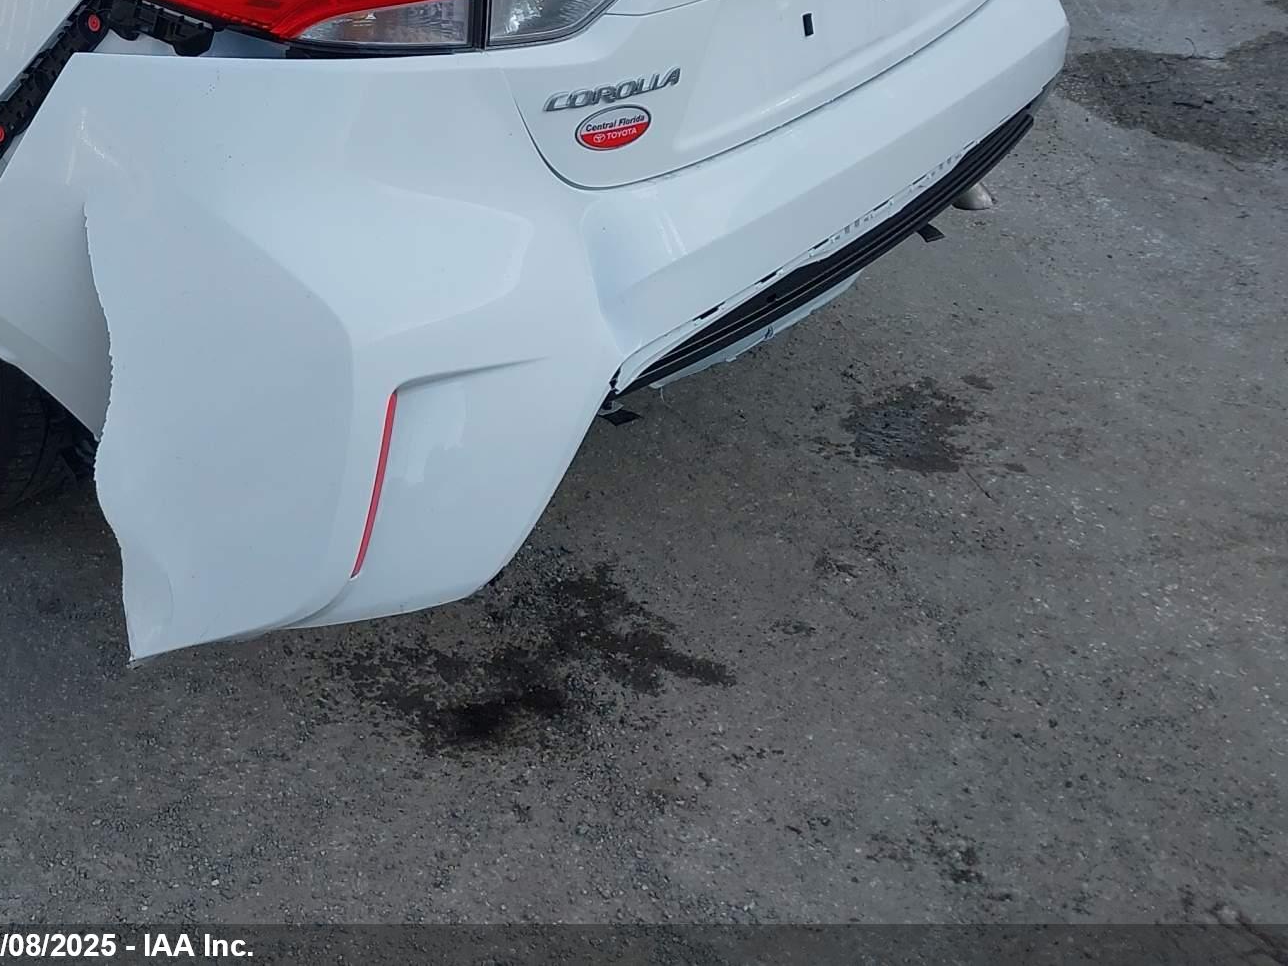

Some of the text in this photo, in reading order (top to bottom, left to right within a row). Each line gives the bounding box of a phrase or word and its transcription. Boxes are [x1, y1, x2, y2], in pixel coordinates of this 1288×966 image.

[543, 66, 681, 112] COROLLA
[585, 114, 646, 132] Central Florida
[607, 128, 638, 140] TOYOTA
